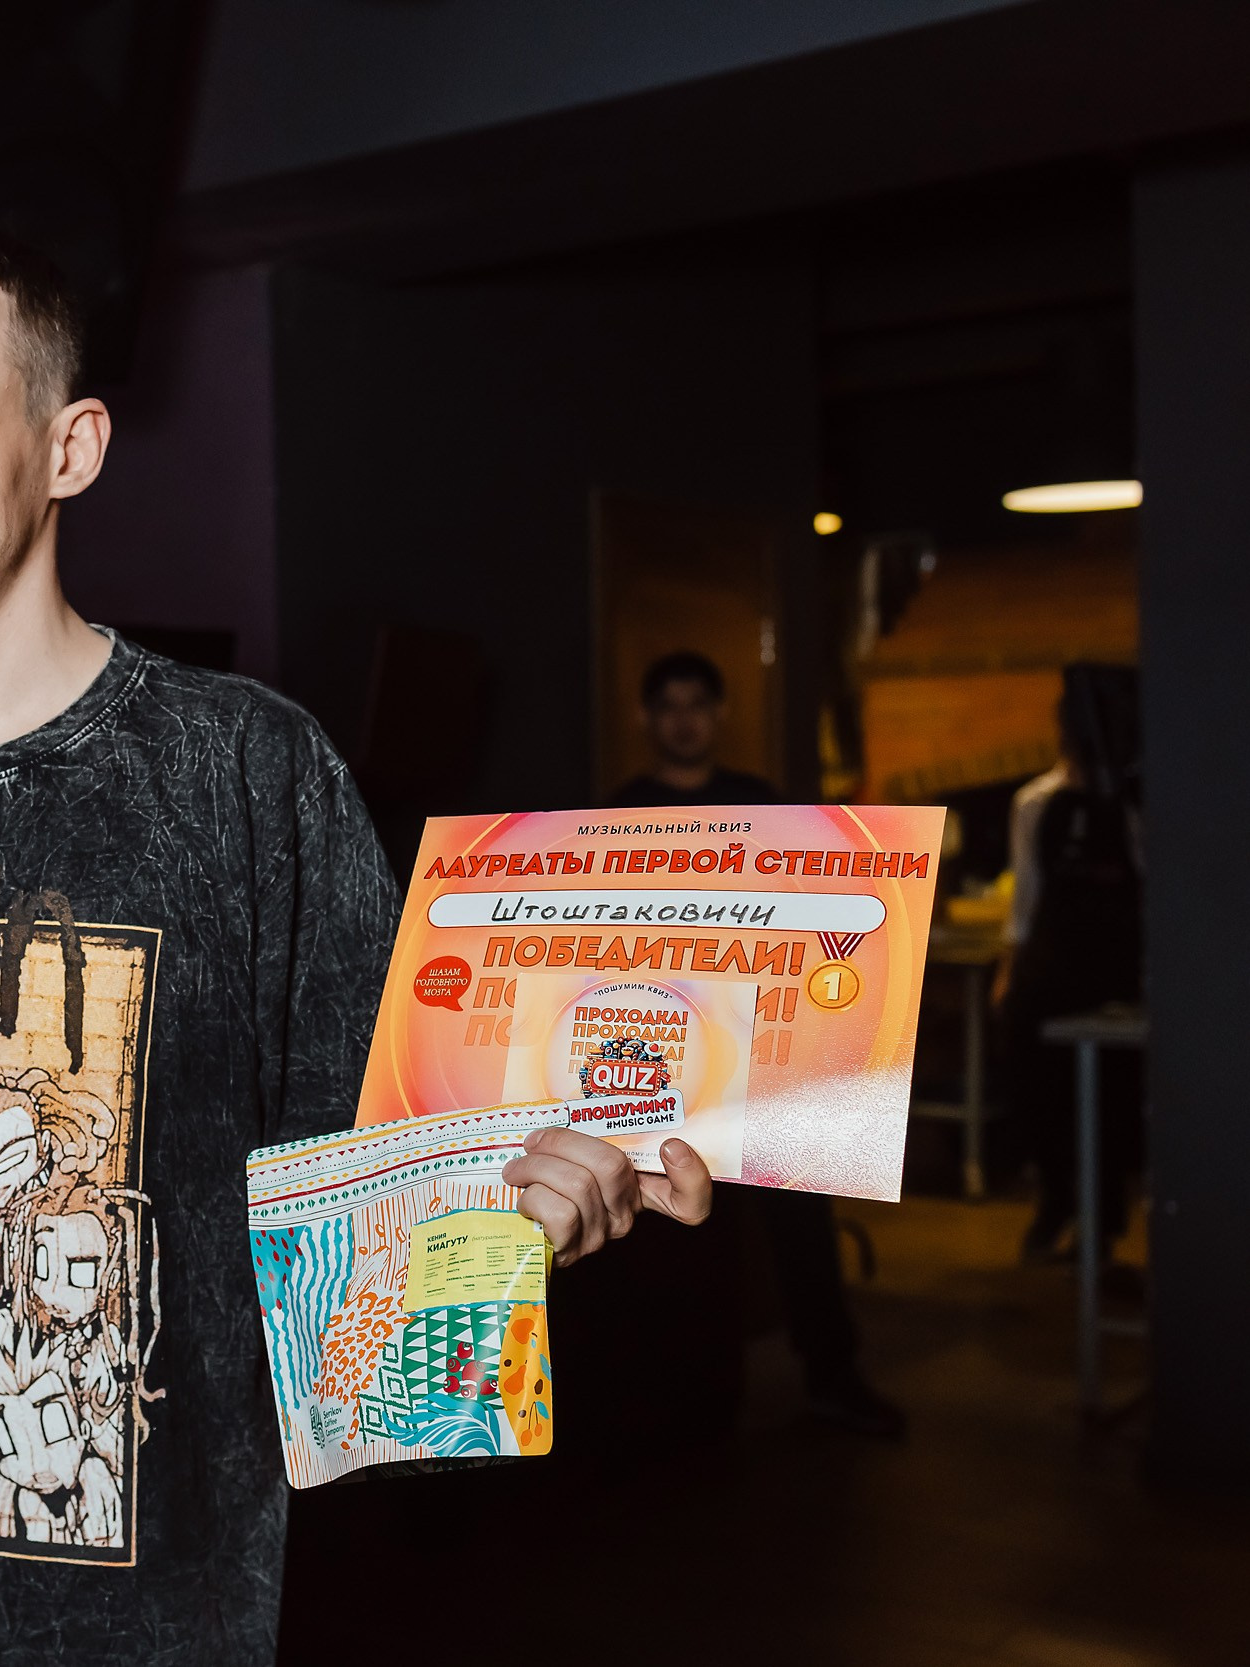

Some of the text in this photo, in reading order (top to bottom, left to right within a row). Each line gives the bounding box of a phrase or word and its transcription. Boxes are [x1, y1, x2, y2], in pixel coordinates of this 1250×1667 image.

[577, 821, 752, 836] МУЗЫКАЛЬНЫЙ КВИЗ
[423, 843, 930, 880] ЛАУРЕАТЫ ПЕРВОЙ СТЕПЕНИ
[491, 897, 776, 926] Штоштаковичи
[482, 936, 806, 976] ПОБЕДИТЕЛИ!
[429, 968, 461, 977] ШАЗАМ
[415, 978, 468, 987] ГОЛОВНОГО
[423, 988, 451, 996] МОЗГА
[594, 983, 673, 999] "ПОШУМИМ КВИЗ"
[823, 971, 842, 1001] 1
[574, 1006, 689, 1026] ПРОХОДКА!
[572, 1023, 687, 1043] ПРОХОДКА!
[592, 1064, 656, 1091] QUIZ
[570, 1097, 676, 1123] #ПОШУМИМ?
[606, 1113, 675, 1129] #MUSIC GAME
[427, 1232, 447, 1242] КЕНИЯ
[427, 1235, 468, 1253] КИАГУТУ
